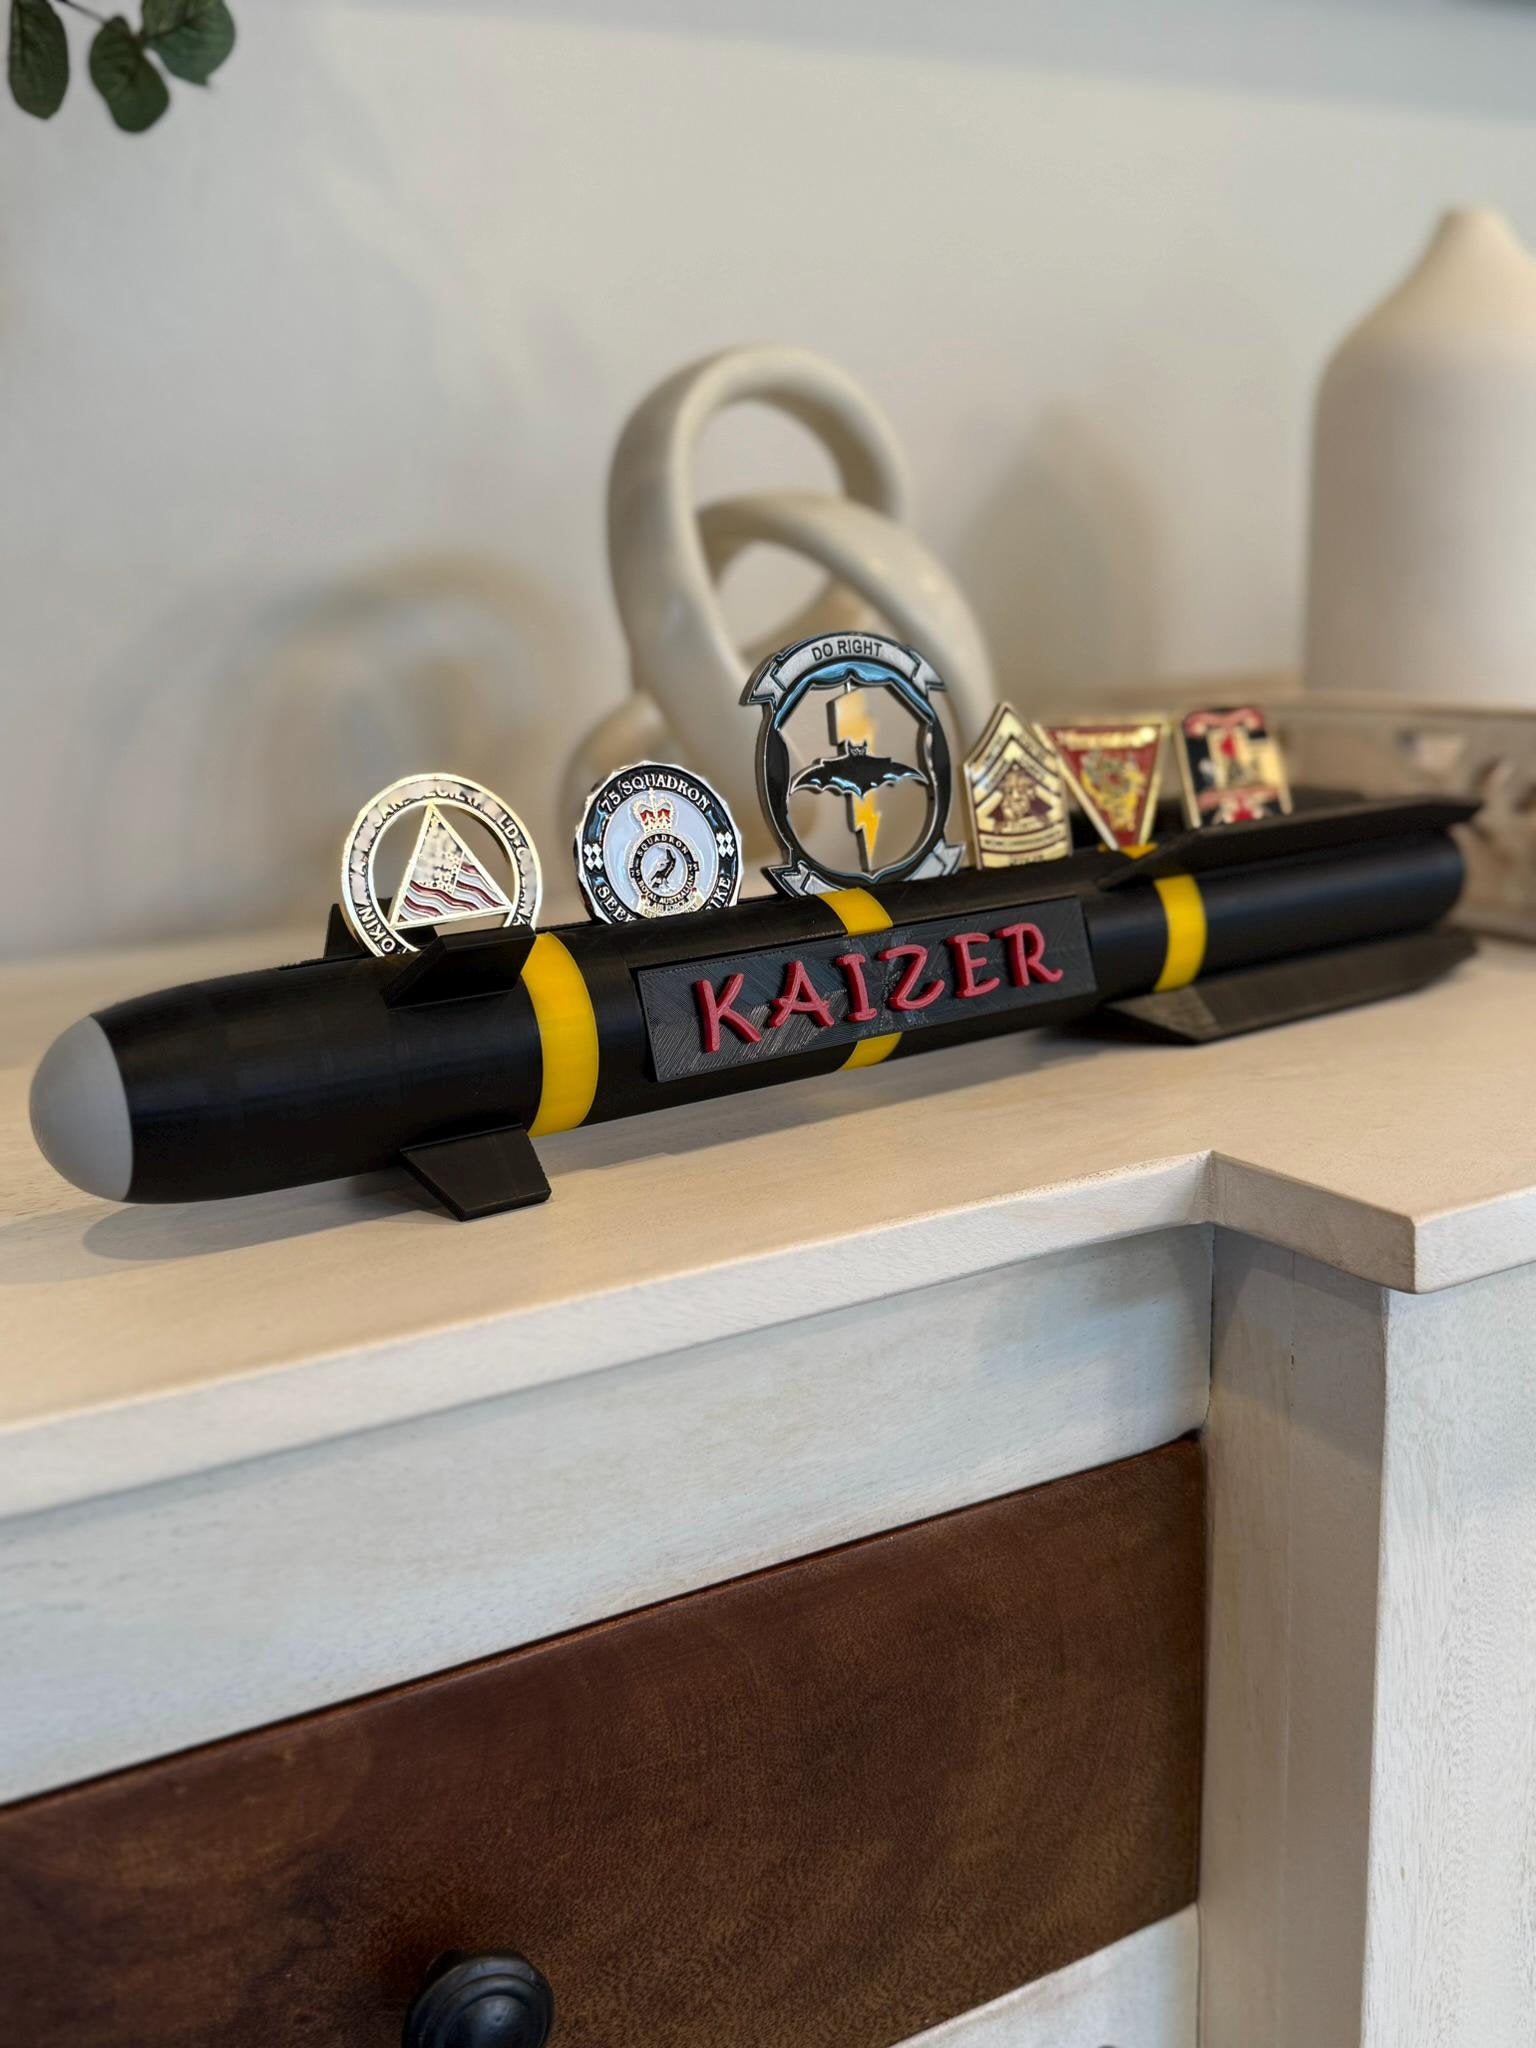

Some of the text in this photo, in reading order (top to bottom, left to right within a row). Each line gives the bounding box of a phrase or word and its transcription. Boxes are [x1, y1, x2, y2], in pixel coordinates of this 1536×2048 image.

[811, 639, 882, 661] DO RIGHT
[601, 773, 711, 812] 75 SQUADRON
[637, 834, 689, 857] SQUADRON
[694, 921, 1064, 1053] KAIZER
